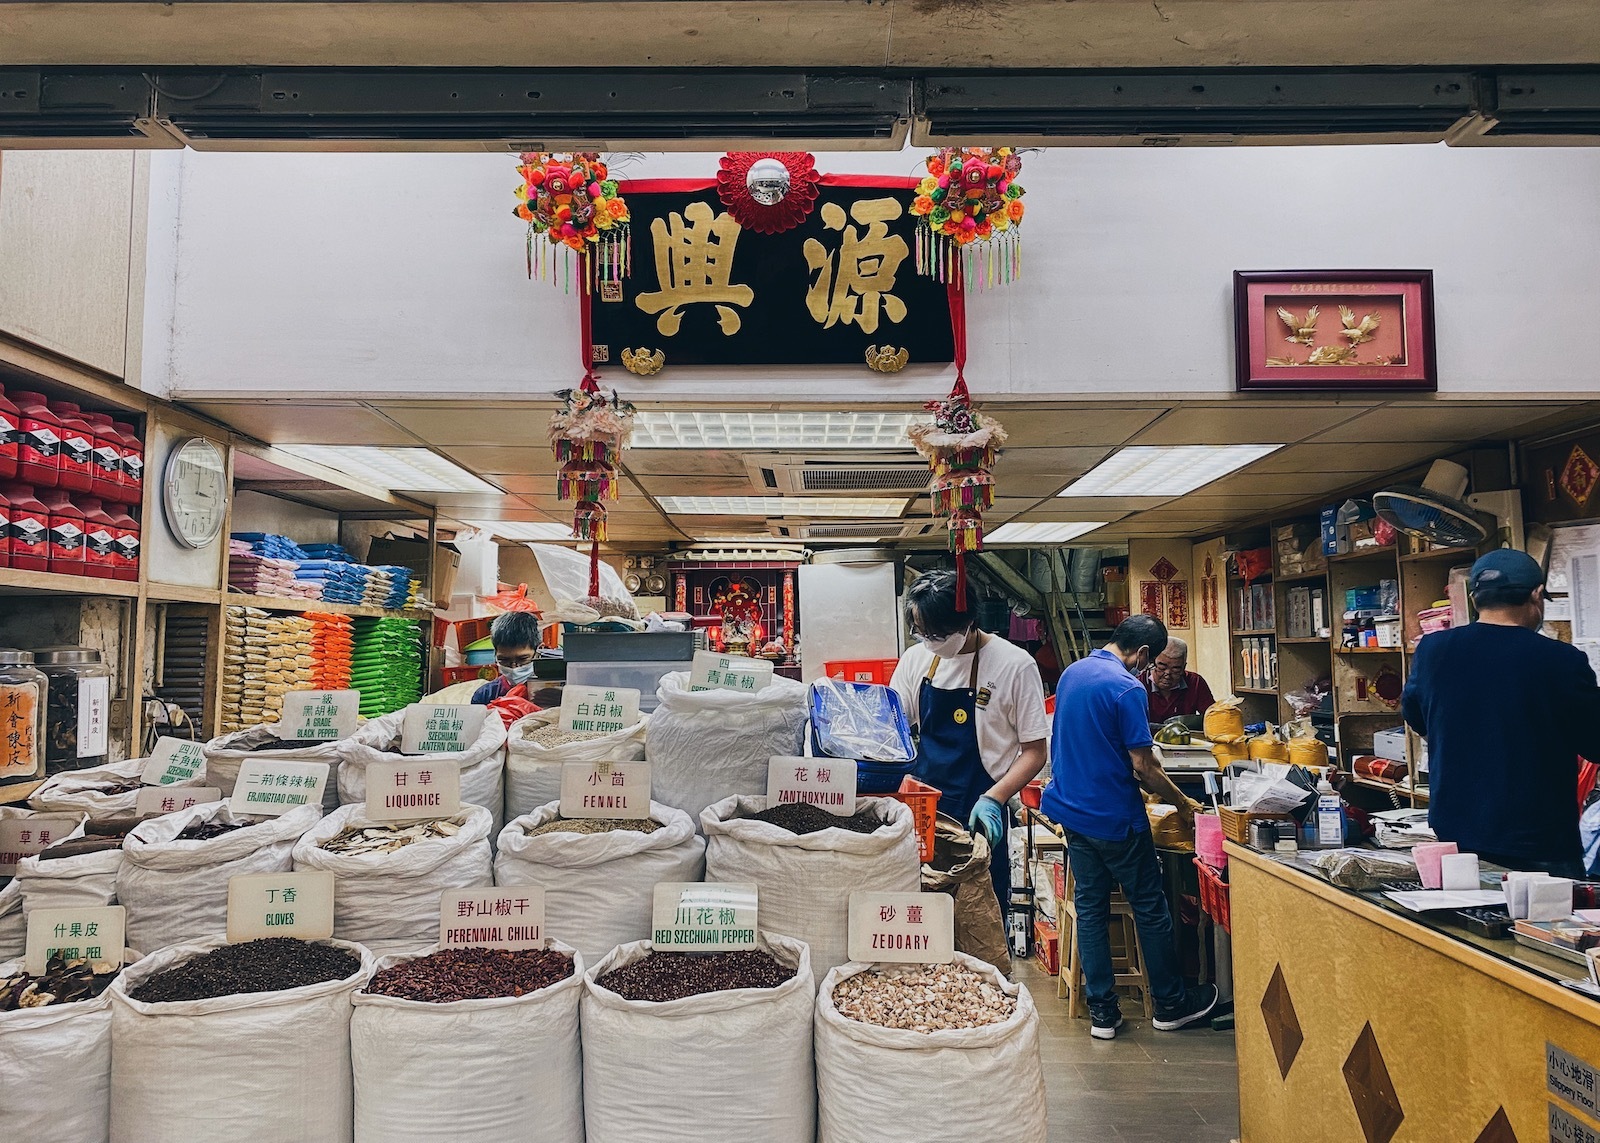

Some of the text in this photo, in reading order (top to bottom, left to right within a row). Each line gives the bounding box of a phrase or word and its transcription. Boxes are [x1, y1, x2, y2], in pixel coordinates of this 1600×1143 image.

[707, 669, 755, 689] 青麻椒
[310, 693, 333, 705] 一級
[588, 691, 615, 702] 一級
[91, 699, 100, 734] 新會陳皮
[302, 705, 338, 717] 黑胡椒
[433, 708, 458, 718] 四川
[577, 702, 623, 718] 白胡椒
[5, 691, 26, 767] 新會陳皮
[305, 718, 331, 727] A GRADE
[572, 719, 624, 733] WHITE PEPPER
[297, 728, 338, 738] BLACK PEPPER
[428, 731, 458, 741] SZECHUAN
[179, 743, 201, 757] 四川
[418, 742, 465, 752] LANTERN CHILLI
[169, 753, 203, 768] 牛角椒
[598, 763, 609, 774] 甜
[794, 767, 831, 783] 花椒
[394, 770, 432, 786] 甘草
[588, 771, 625, 786] 小茴
[161, 797, 196, 811] 桂皮
[247, 791, 308, 805] ERJINGTIAO CHILLI
[386, 793, 440, 808] LIQUORICE
[583, 795, 627, 808] FENNEL
[778, 789, 844, 805] ZANTHOXYLUM
[19, 830, 50, 845] 草果
[265, 887, 297, 903] 丁香
[457, 898, 531, 917] 野山椒干
[880, 905, 923, 924] 砂薑
[265, 912, 294, 926] CLOVES
[674, 907, 736, 926] 川花椒
[53, 921, 99, 938] 什果皮
[447, 925, 539, 943] PERENNIAL CHILLI
[655, 929, 754, 944] RED SZECHUAN PEPPER
[872, 933, 929, 950] ZEDOARY
[86, 946, 102, 959] PEEL
[1549, 1051, 1594, 1092] 小心地滑
[1549, 1074, 1594, 1109] Slippery Floor
